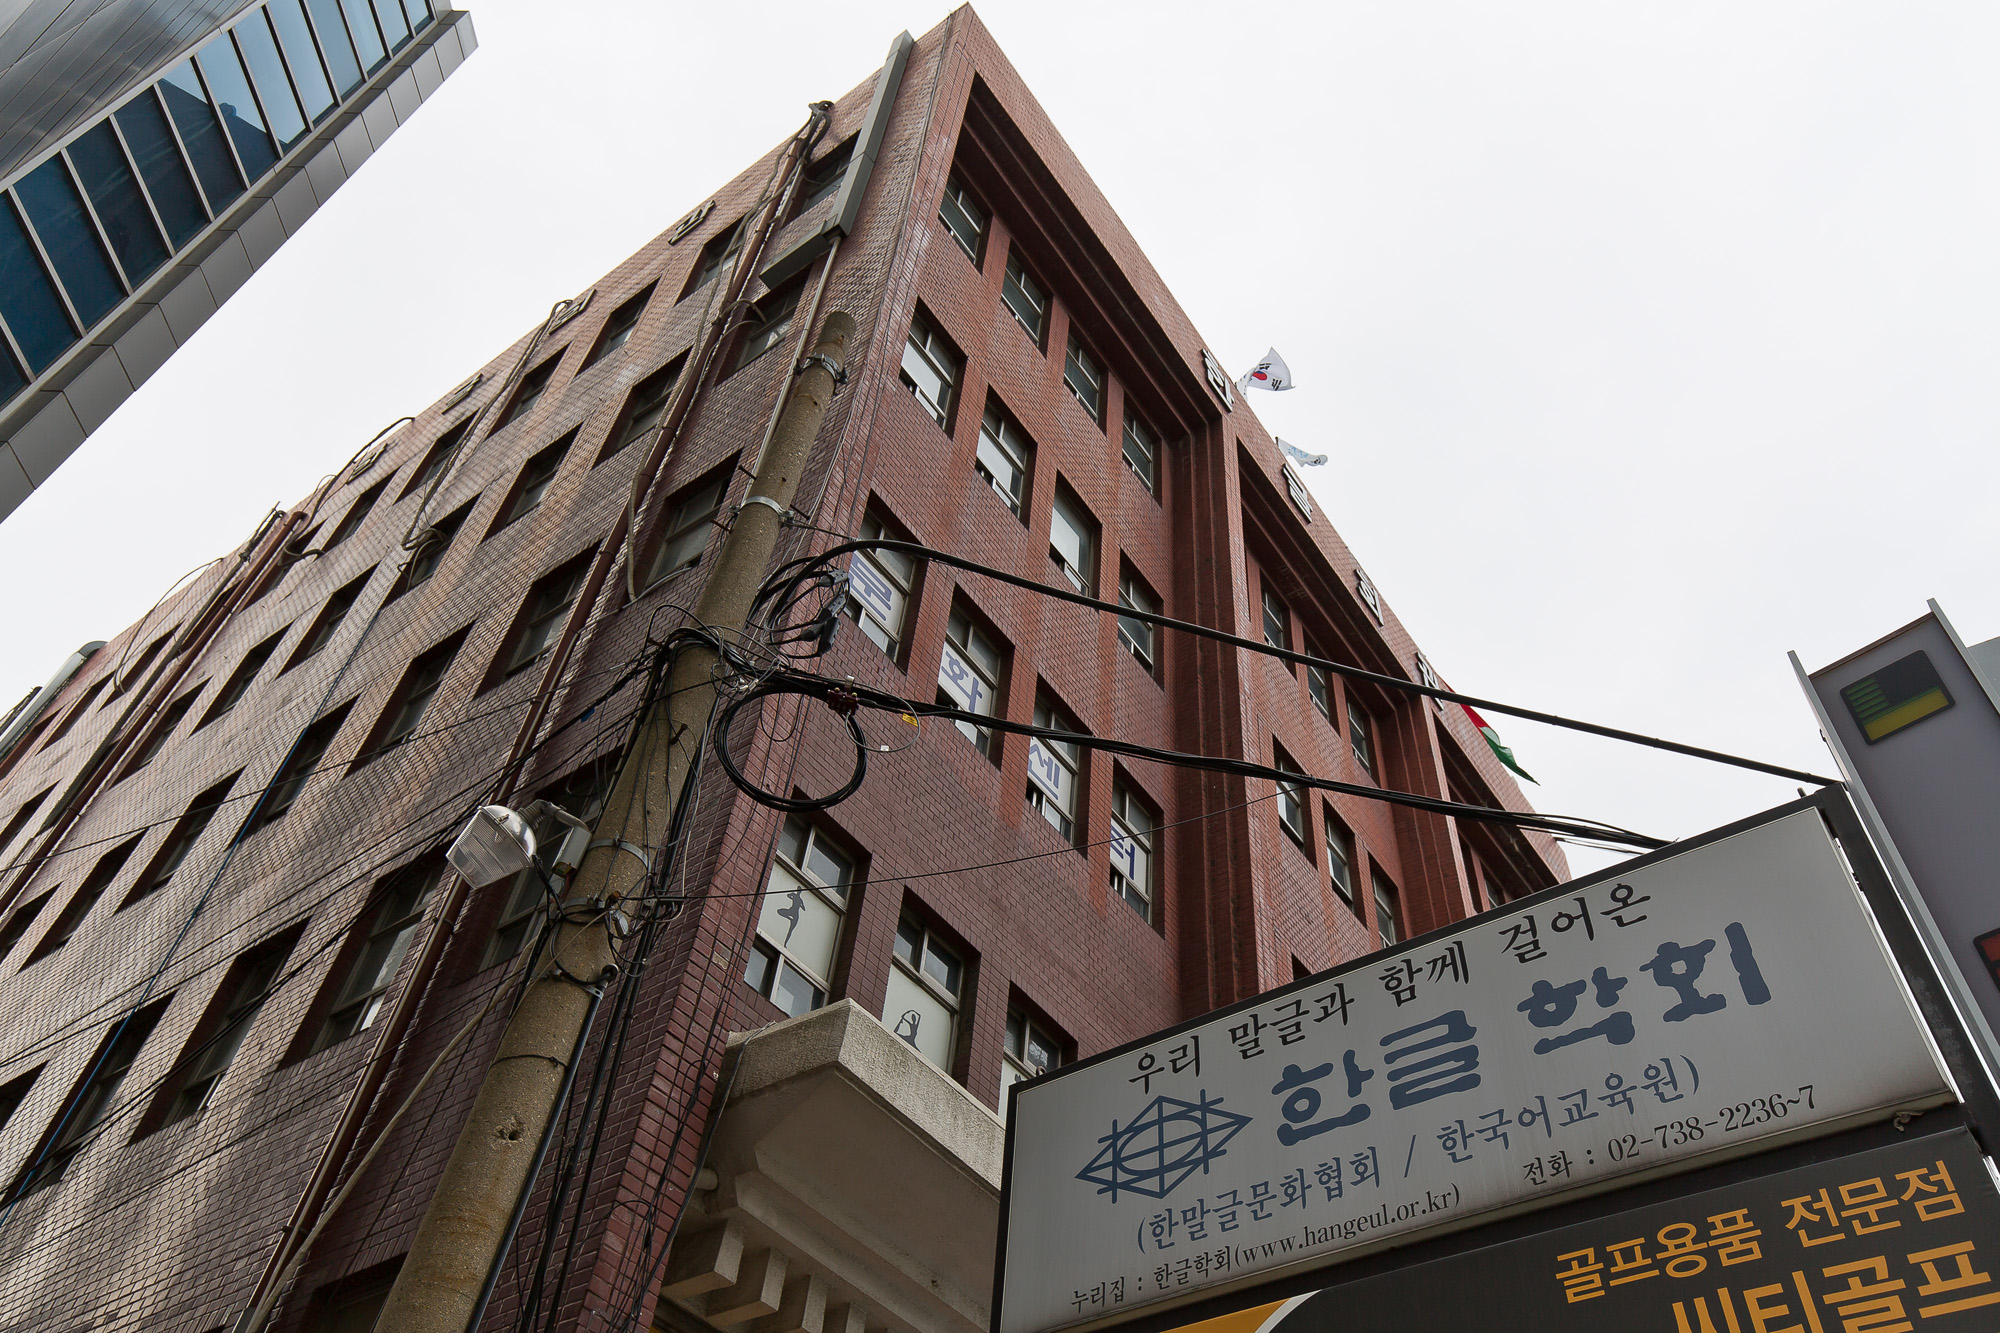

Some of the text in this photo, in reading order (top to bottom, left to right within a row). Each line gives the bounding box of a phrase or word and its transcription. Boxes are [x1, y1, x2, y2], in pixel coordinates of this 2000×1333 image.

[1129, 882, 1651, 1095] 우리 말글과 함께 걸어온
[1271, 922, 1772, 1147] 한글 학회
[1437, 1055, 1700, 1163] 한국어교육원)
[1522, 1150, 1574, 1186] 전화
[1607, 1085, 1816, 1162] 02-738-2236~7
[1071, 1276, 1126, 1314] 누리집
[1556, 1160, 1965, 1304] 골프용품 전문점
